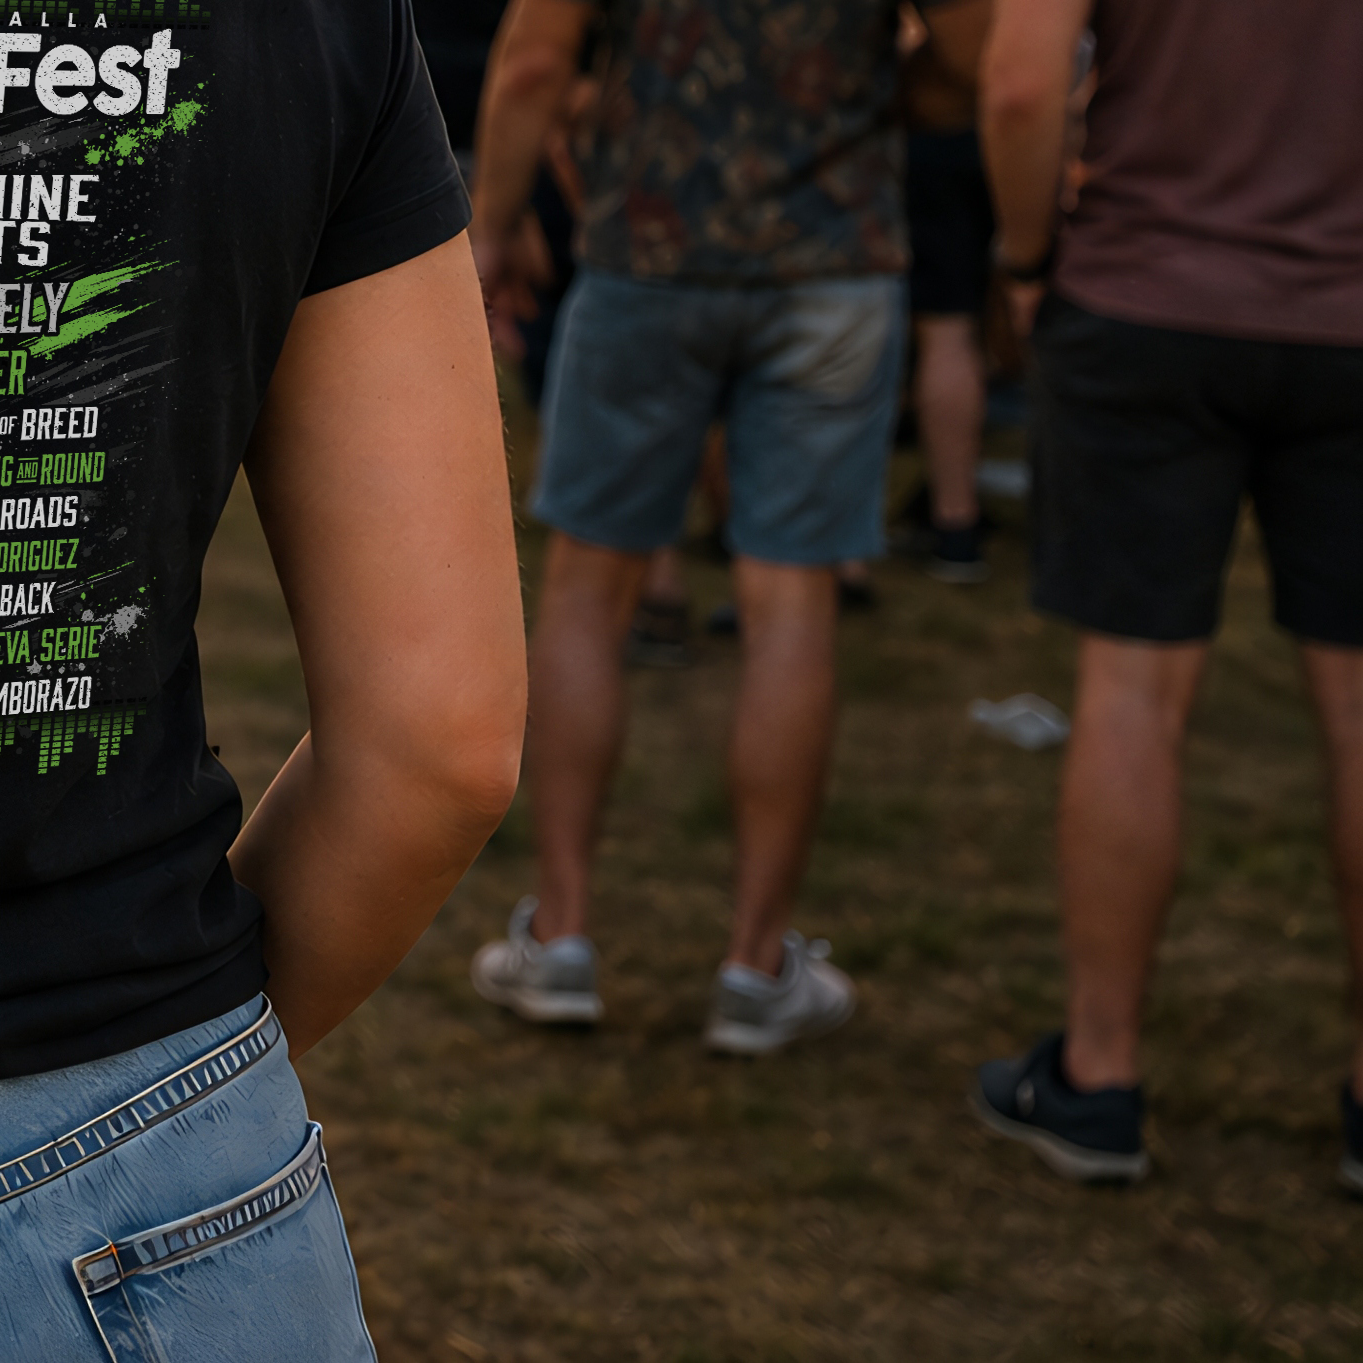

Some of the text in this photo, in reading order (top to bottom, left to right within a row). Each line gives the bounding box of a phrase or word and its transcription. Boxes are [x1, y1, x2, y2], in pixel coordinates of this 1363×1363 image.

[0, 415, 18, 435] OF
[21, 406, 99, 442] BREED
[16, 461, 39, 481] AND
[39, 451, 106, 487] ROUND
[0, 495, 79, 531] ROADS
[39, 624, 103, 662] SERIE
